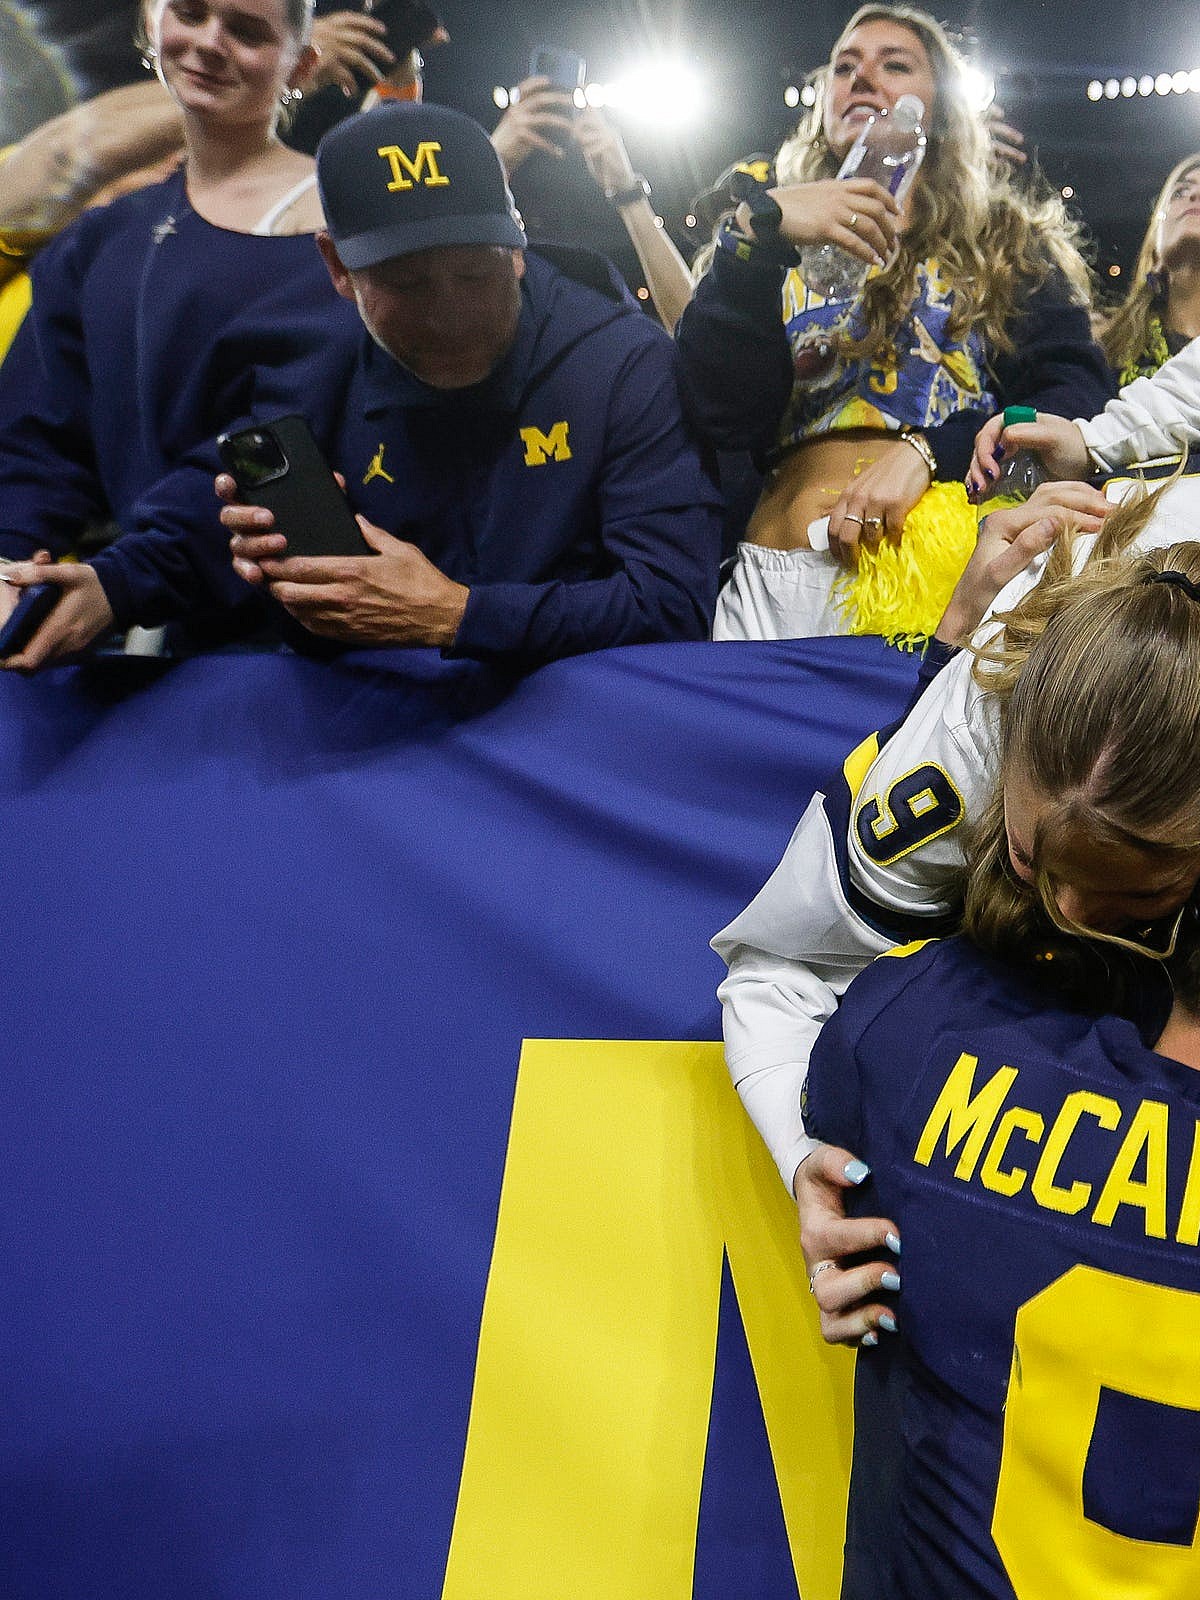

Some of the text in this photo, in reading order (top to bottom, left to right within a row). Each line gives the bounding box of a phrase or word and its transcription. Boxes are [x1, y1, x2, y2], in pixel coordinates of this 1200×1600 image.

[377, 141, 450, 192] M
[519, 420, 573, 467] M
[855, 761, 966, 867] 9
